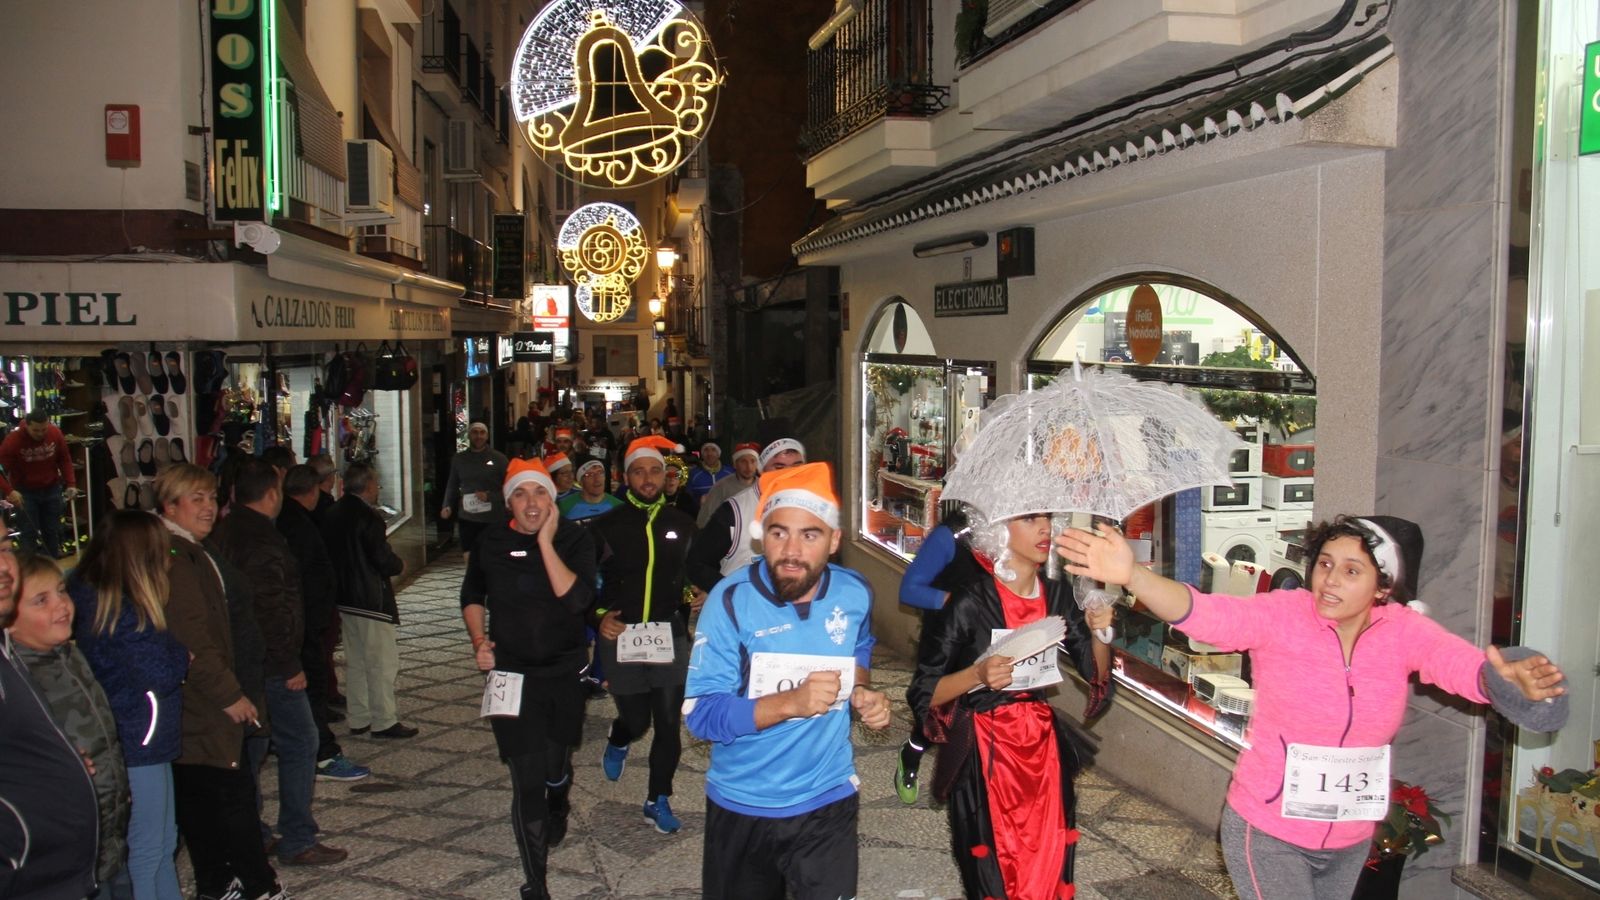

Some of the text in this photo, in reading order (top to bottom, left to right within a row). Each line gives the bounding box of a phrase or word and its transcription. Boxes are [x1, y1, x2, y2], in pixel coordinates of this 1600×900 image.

[215, 139, 260, 209] Felix
[3, 292, 137, 326] PIEL
[936, 284, 1004, 310] ELECTROMAR
[264, 295, 356, 329] CALZADOS FELIX
[632, 634, 664, 647] 036
[1301, 752, 1319, 761] San
[1315, 772, 1369, 792] 143
